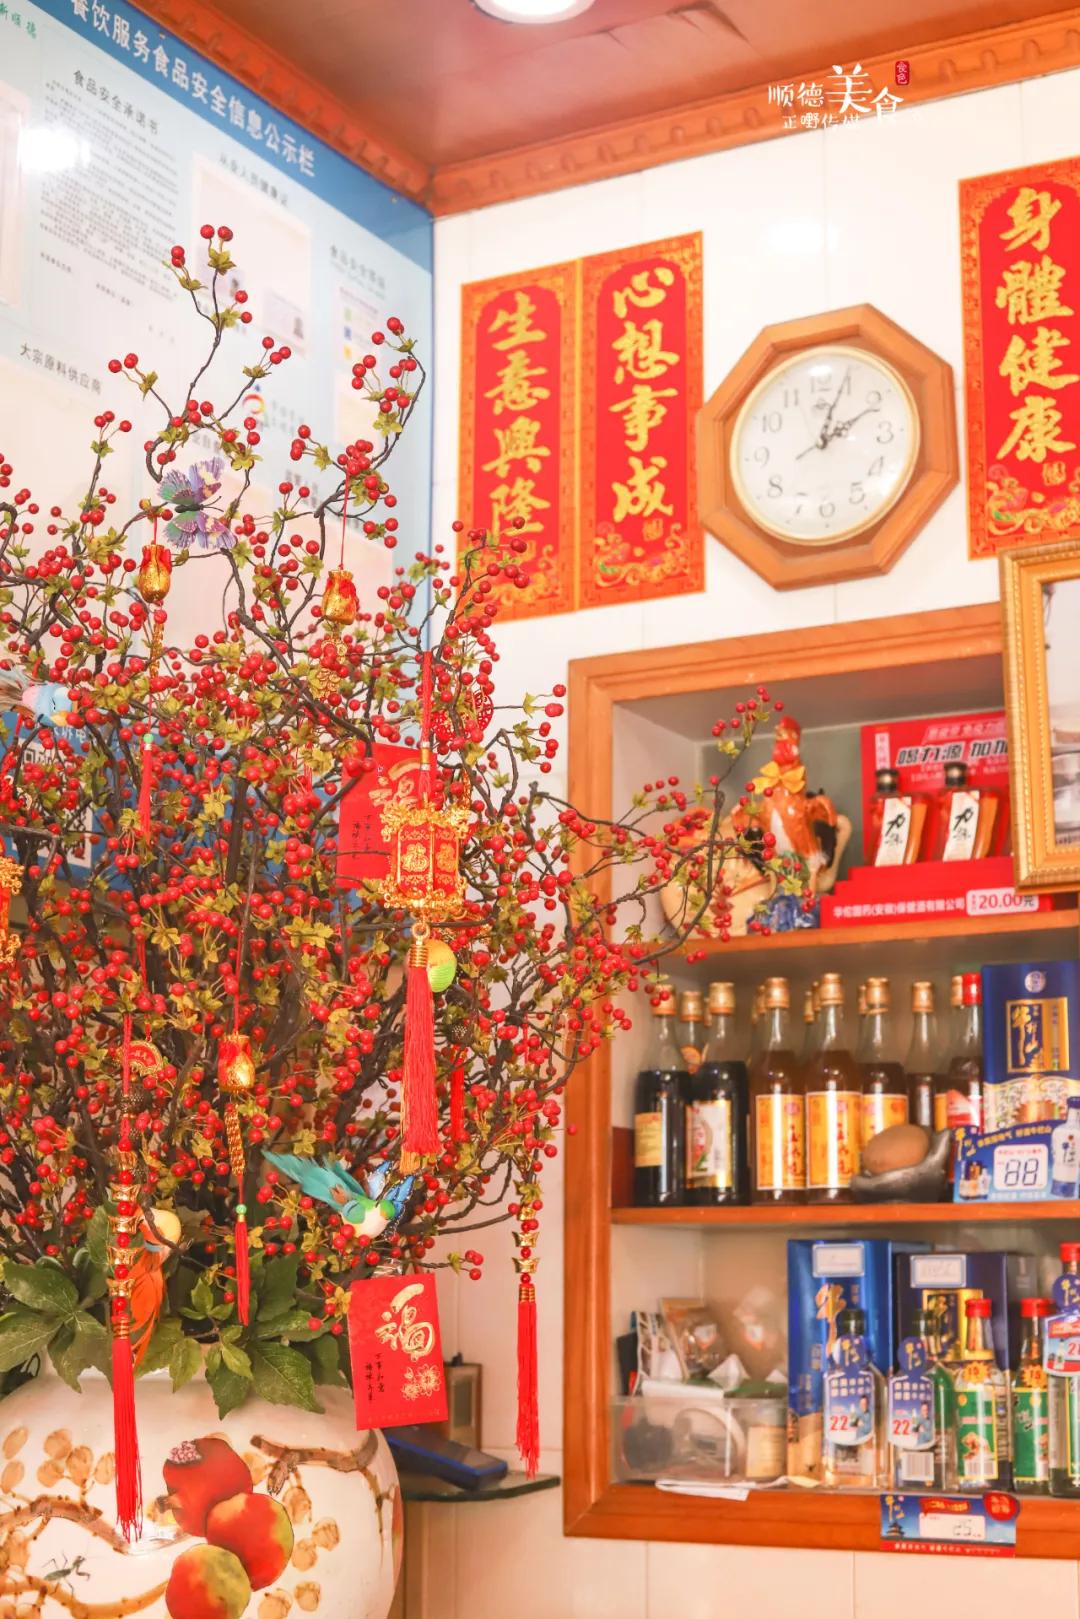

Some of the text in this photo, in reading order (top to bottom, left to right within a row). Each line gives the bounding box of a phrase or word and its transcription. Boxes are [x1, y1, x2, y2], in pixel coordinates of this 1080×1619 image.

[995, 187, 1080, 464] 身體健康
[608, 266, 680, 523] 心想事成
[481, 290, 552, 537] 生意興隆
[762, 411, 783, 433] 10
[876, 421, 894, 445] 3
[754, 446, 770, 468] 9
[868, 456, 886, 478] 4
[767, 476, 784, 499] 8
[849, 482, 866, 504] 5
[375, 1283, 435, 1362] 福
[830, 1415, 848, 1431] 22
[893, 1418, 910, 1436] 22
